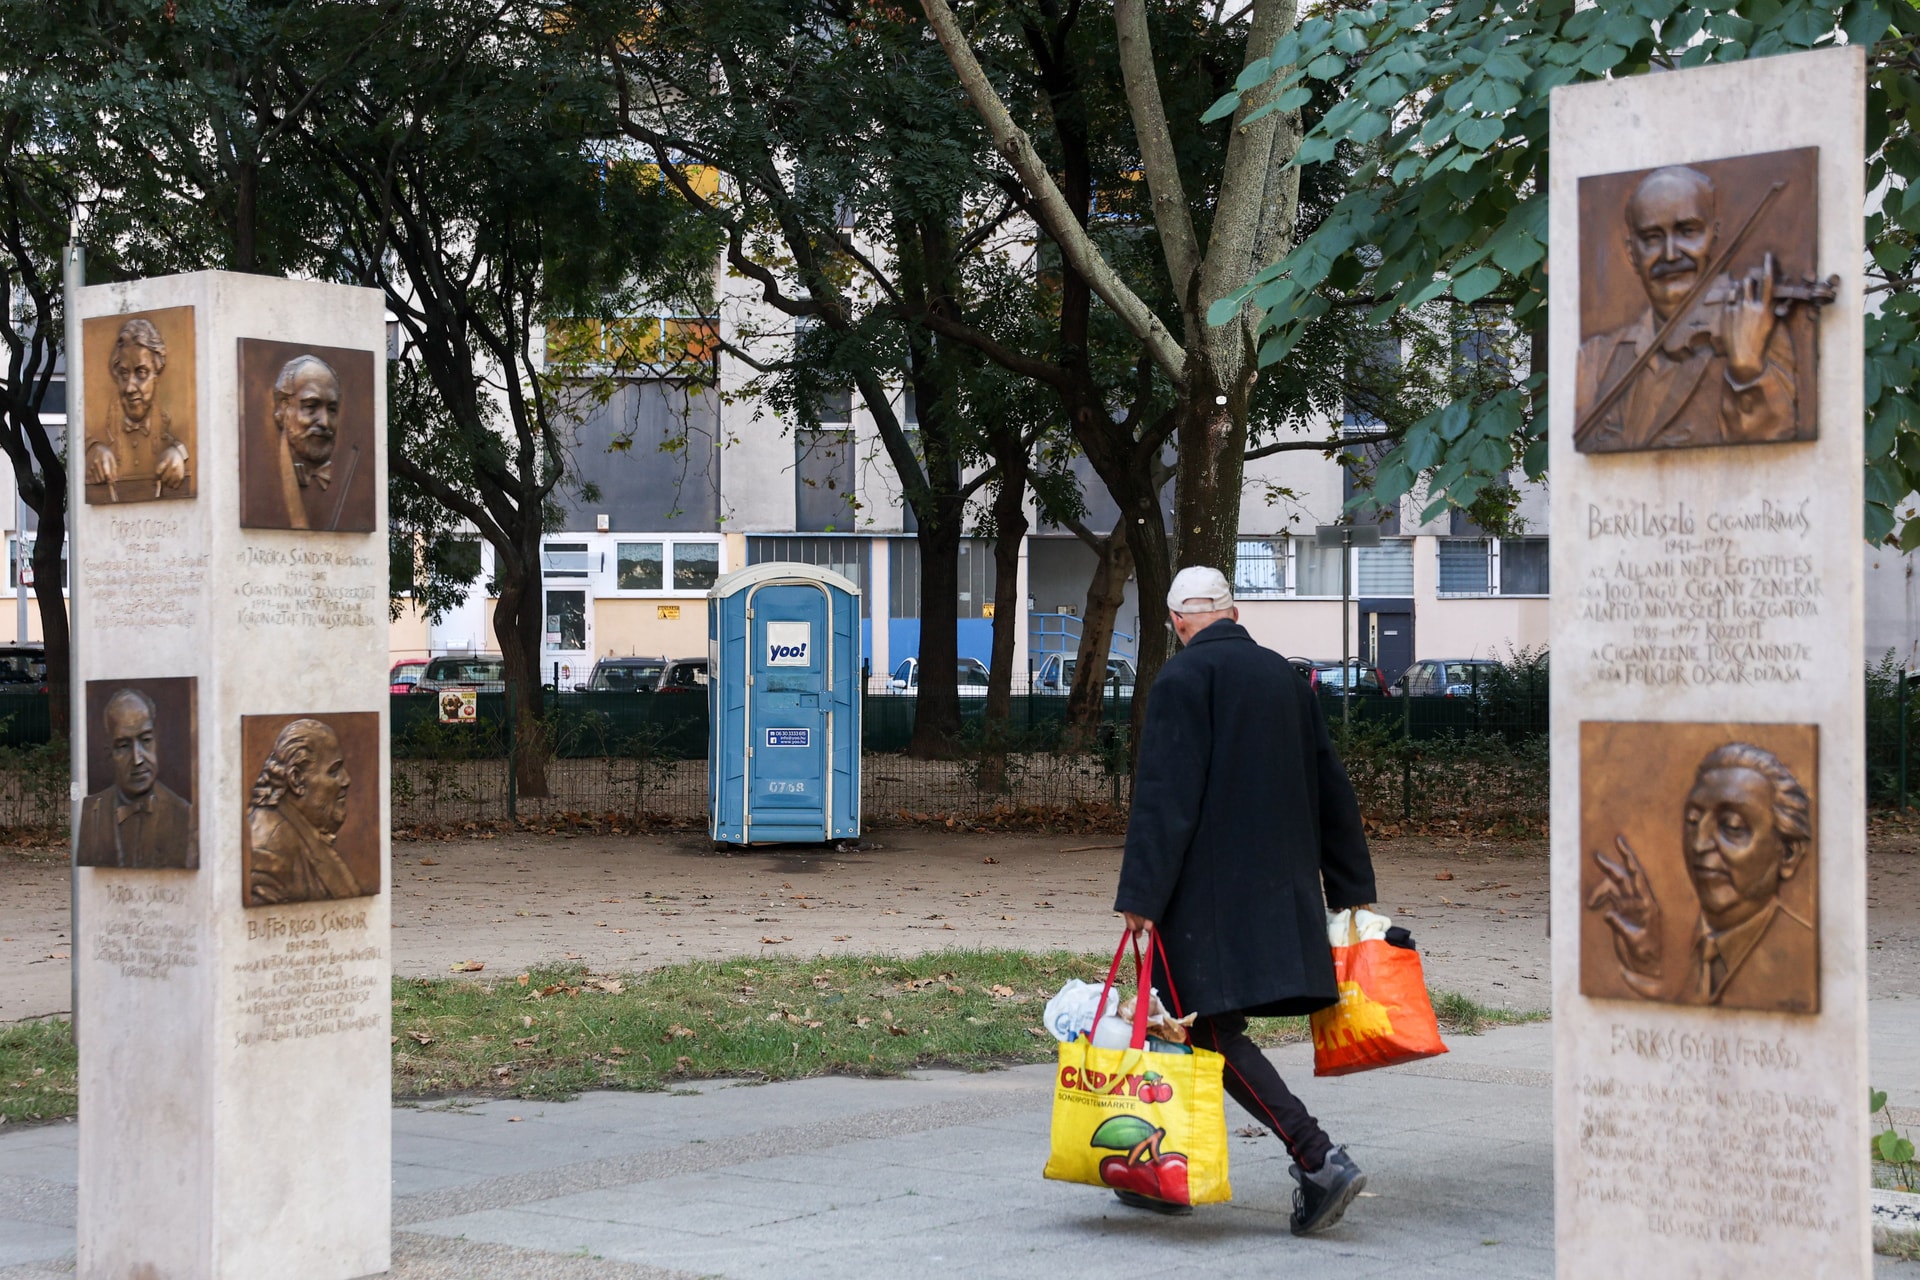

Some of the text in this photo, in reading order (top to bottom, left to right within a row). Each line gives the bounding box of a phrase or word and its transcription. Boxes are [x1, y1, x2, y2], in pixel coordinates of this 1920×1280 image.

[1588, 503, 1638, 541] BERKI
[770, 642, 807, 662] yoo!
[769, 781, 804, 793] 0768
[320, 910, 369, 936] SÁNDOR
